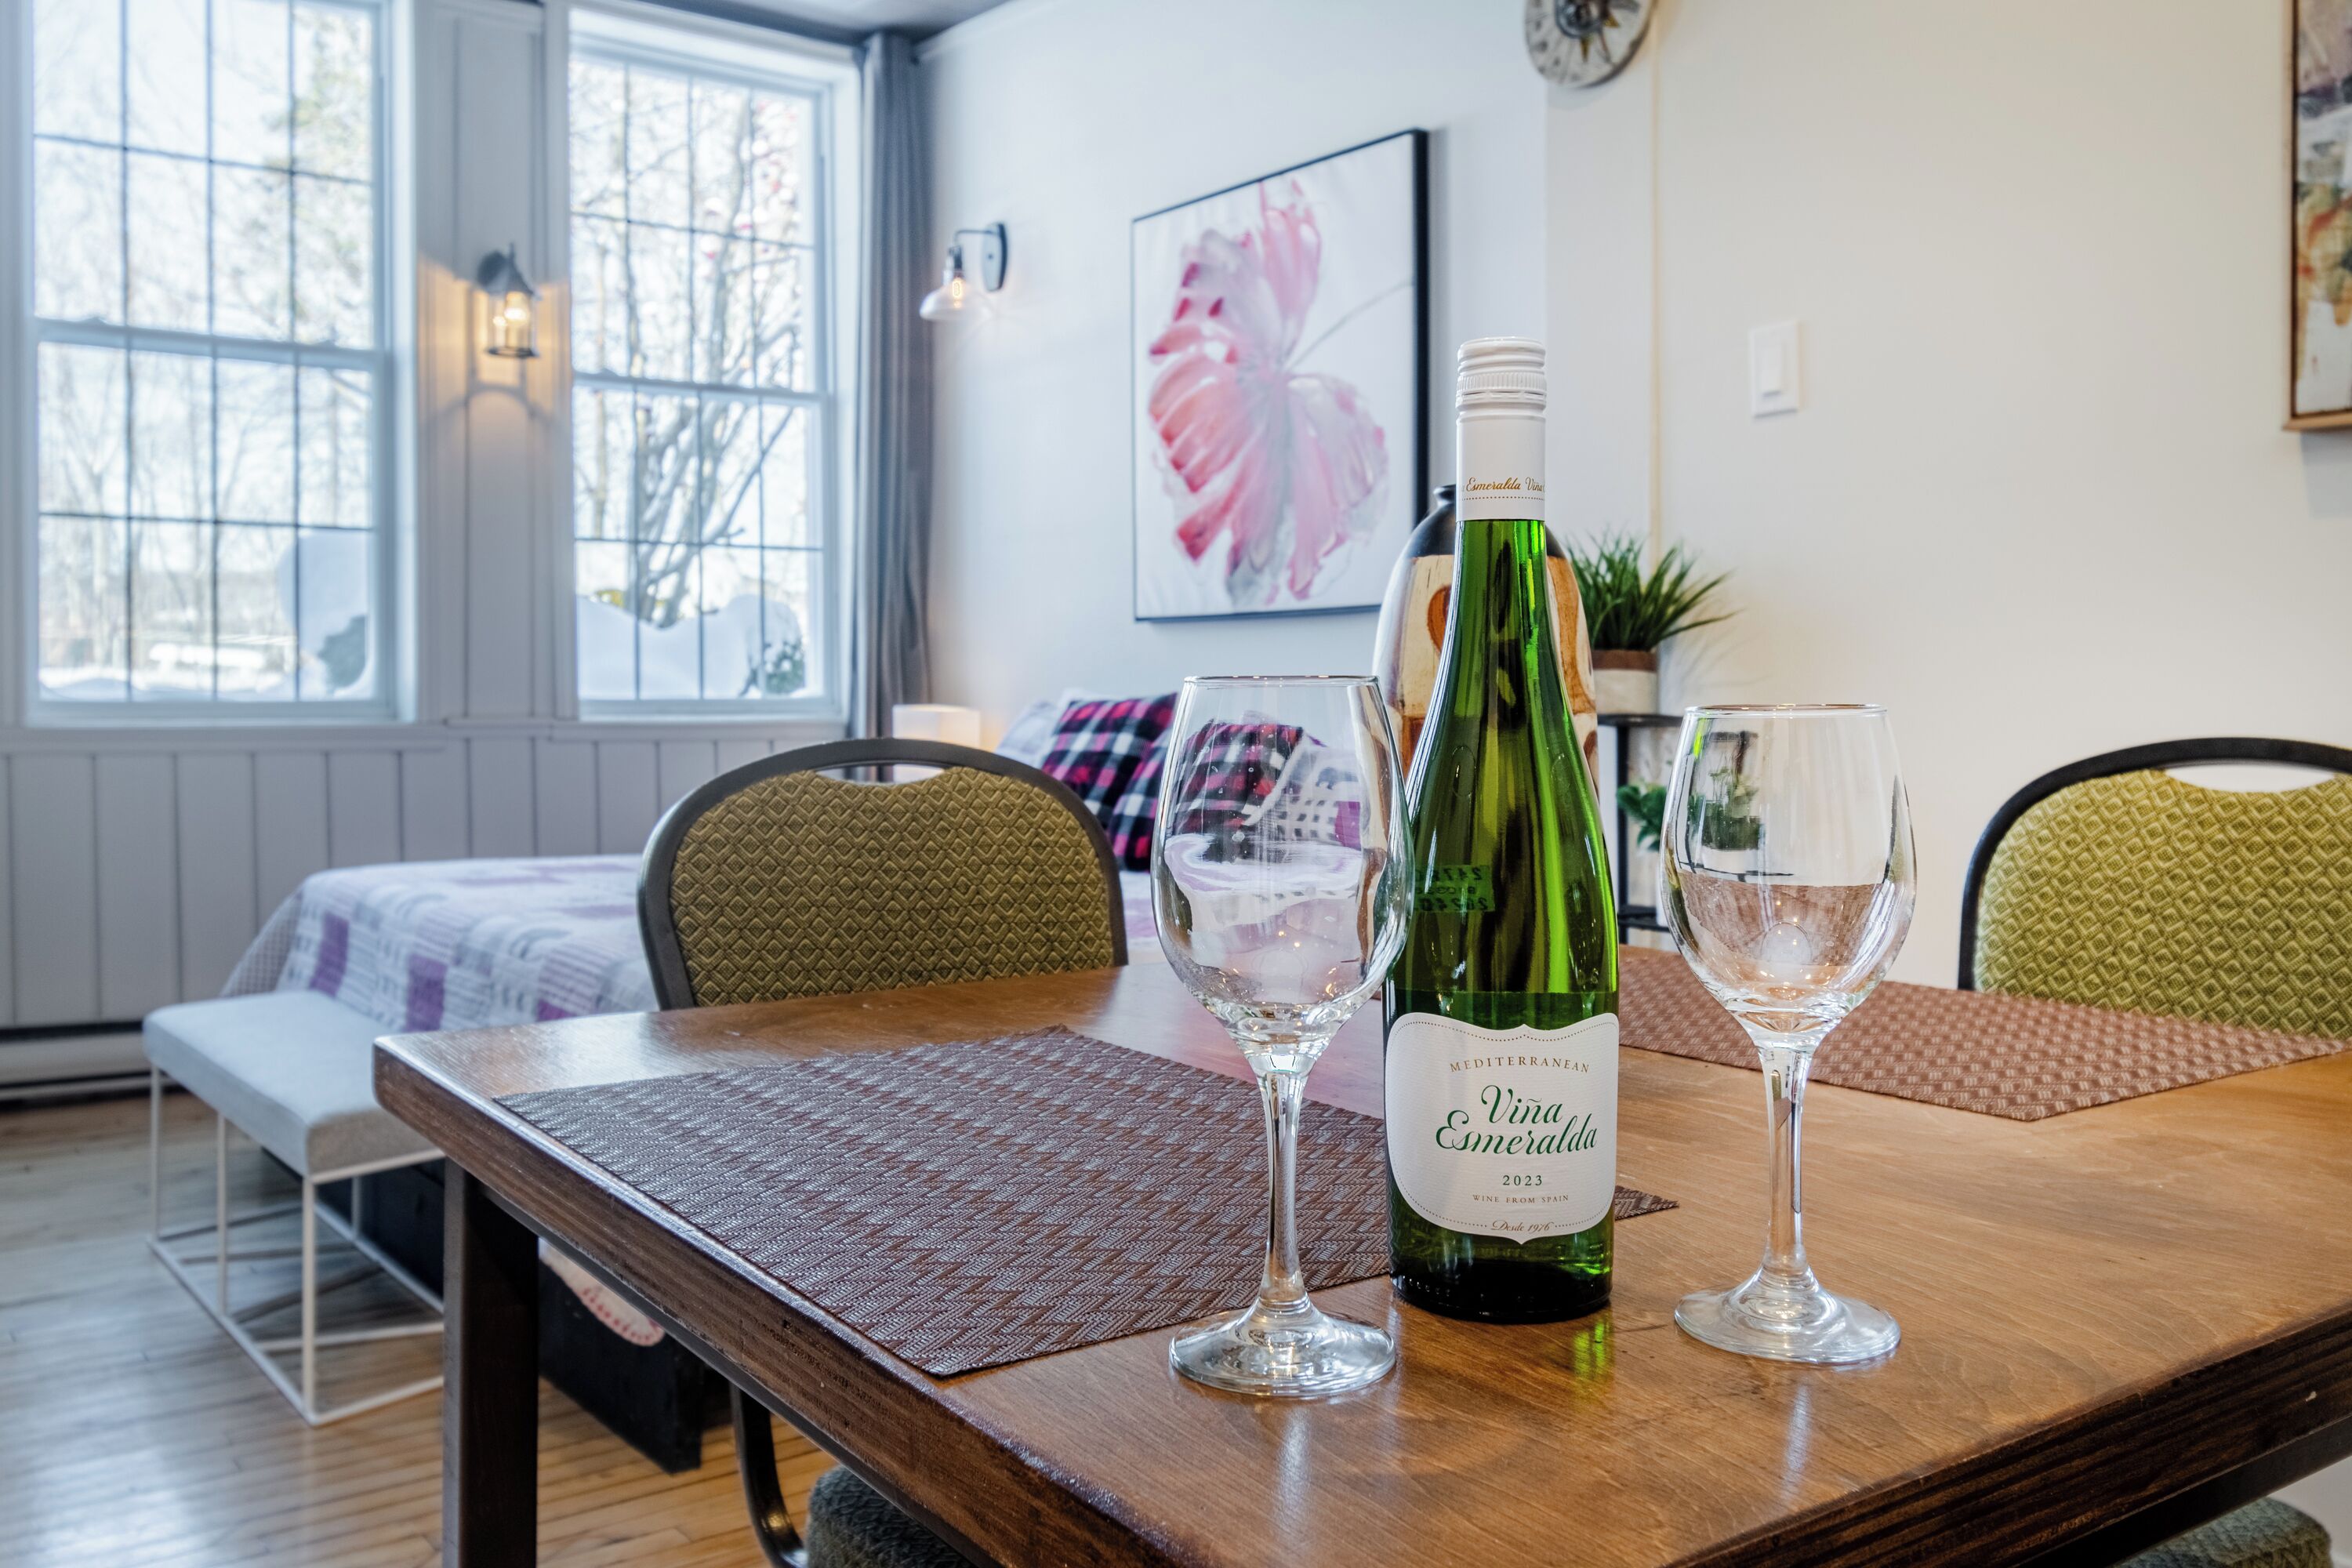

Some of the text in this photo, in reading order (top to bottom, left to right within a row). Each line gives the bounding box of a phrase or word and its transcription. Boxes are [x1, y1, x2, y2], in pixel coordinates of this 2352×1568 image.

[1466, 477, 1522, 492] Esmeralda
[1450, 1056, 1590, 1073] MEDITERRANEAN
[1481, 1085, 1563, 1124] Viña
[1436, 1110, 1597, 1155] Esmeralda
[1502, 1175, 1543, 1186] 2023
[1491, 1220, 1554, 1232] Desde 1976
